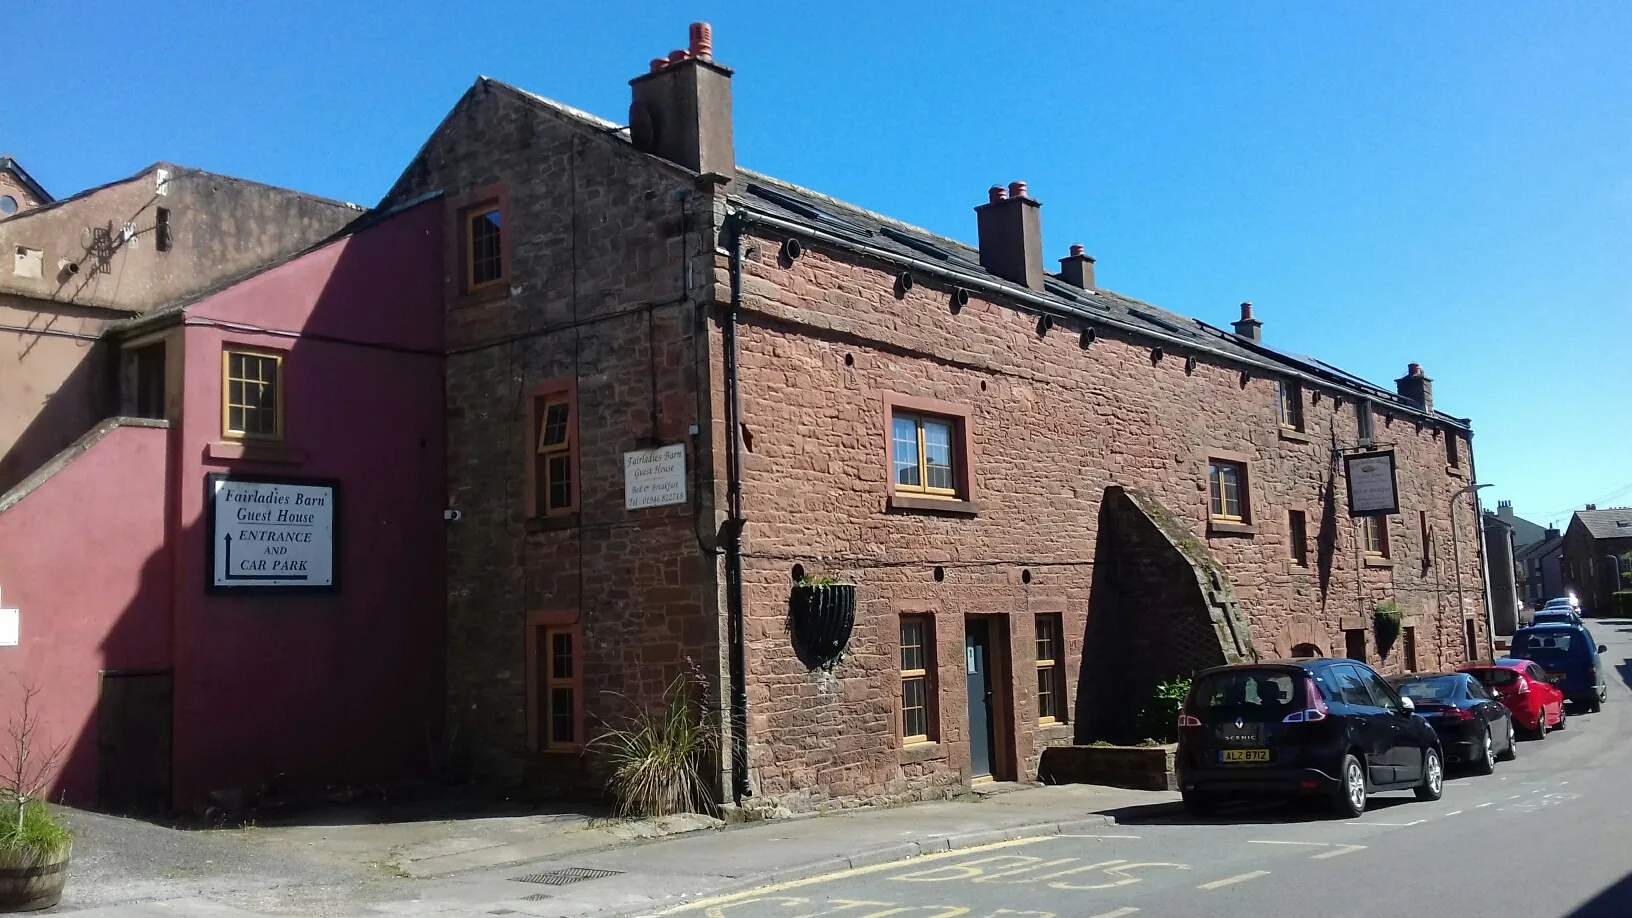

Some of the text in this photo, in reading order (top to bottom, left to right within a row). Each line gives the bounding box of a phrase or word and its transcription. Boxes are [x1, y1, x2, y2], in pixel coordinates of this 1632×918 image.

[225, 489, 325, 507] Fairladies Barn
[237, 507, 315, 523] Guest House
[239, 530, 313, 543] ENTRANCE
[263, 546, 288, 555] AND
[240, 559, 308, 571] CAR PARK
[1226, 751, 1266, 760] ALZ 8712
[884, 855, 1190, 890] BUS
